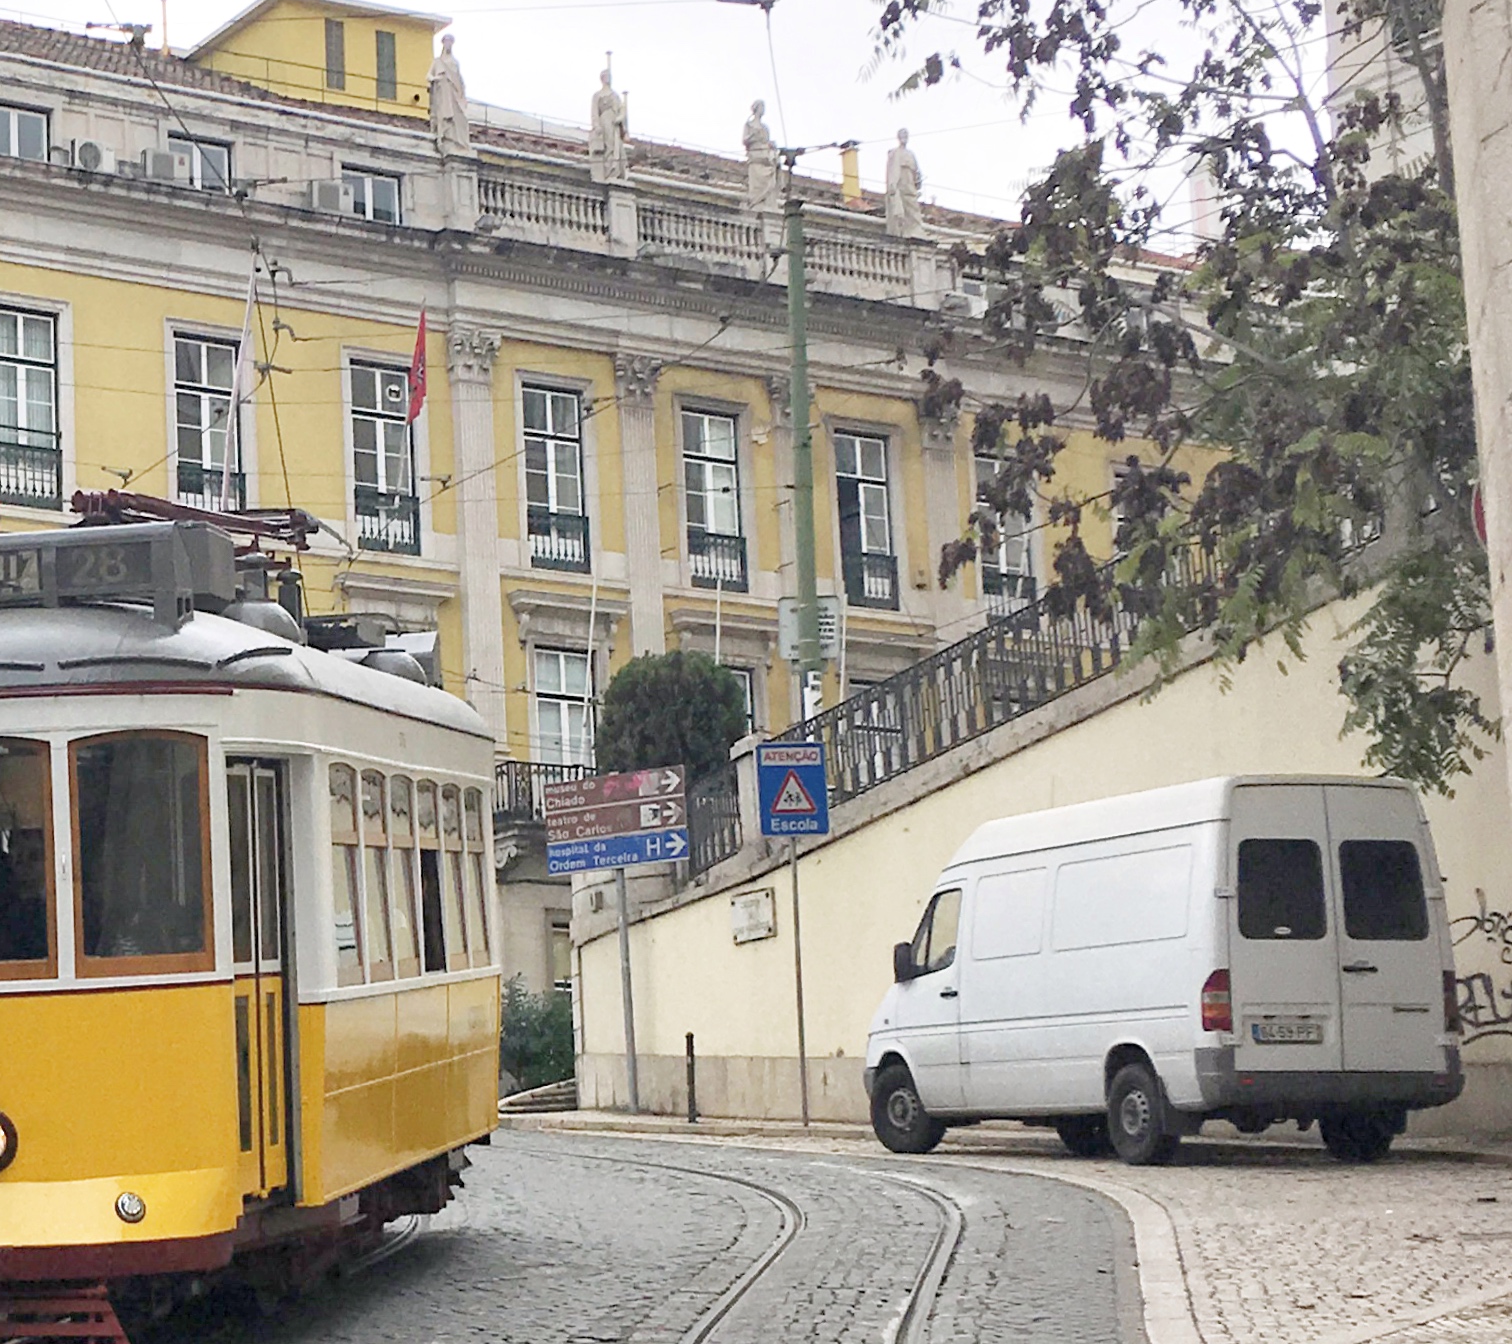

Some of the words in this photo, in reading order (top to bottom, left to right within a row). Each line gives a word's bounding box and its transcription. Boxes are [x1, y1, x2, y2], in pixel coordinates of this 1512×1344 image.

[71, 546, 128, 586] 28
[763, 749, 819, 763] ATENÇÃO
[545, 783, 577, 795] museu
[583, 781, 596, 790] do
[546, 796, 586, 809] Chiado
[547, 814, 578, 827] teatro
[583, 812, 596, 822] de
[770, 817, 819, 832] Escola
[548, 828, 570, 842] São
[576, 824, 612, 838] Carlos
[549, 843, 589, 858] hospital
[593, 842, 607, 852] da
[549, 859, 587, 872] Ordem
[593, 852, 639, 866] Terceira
